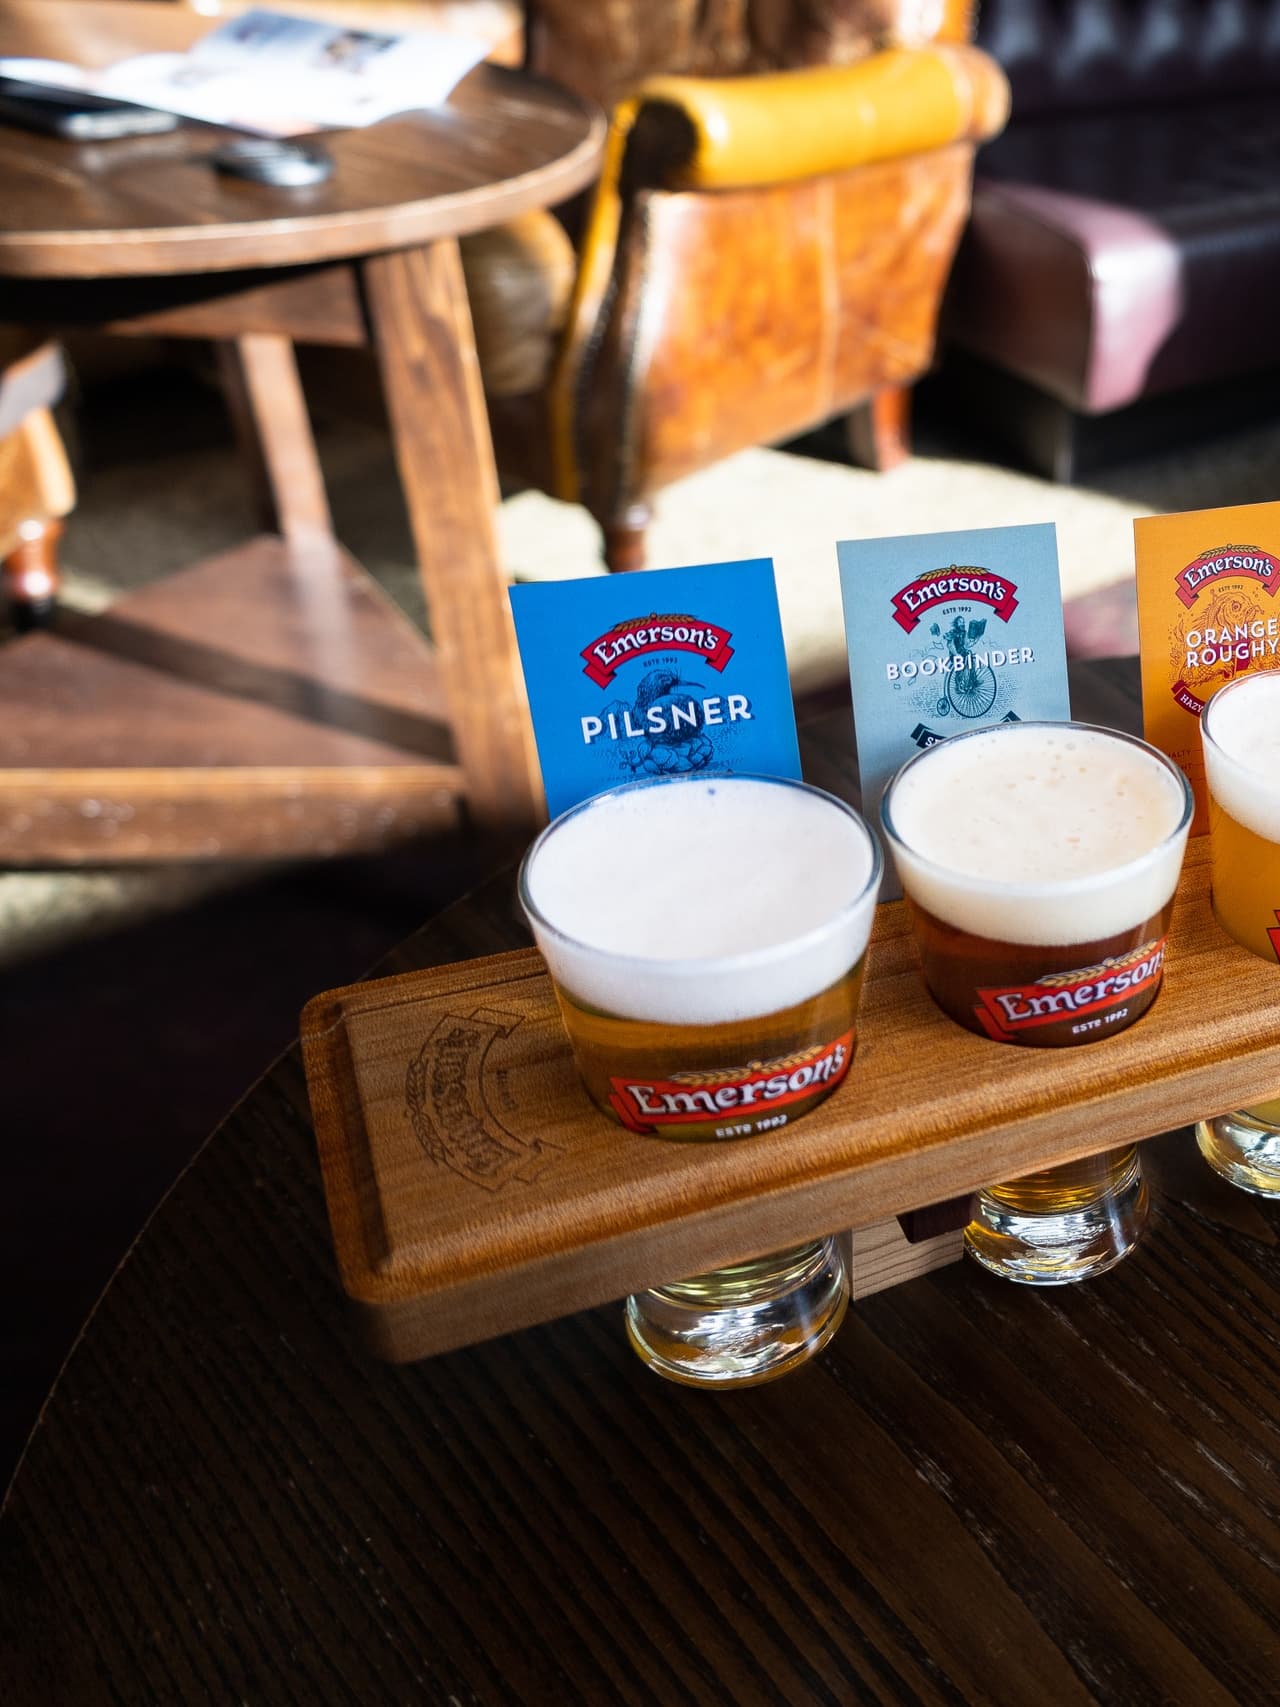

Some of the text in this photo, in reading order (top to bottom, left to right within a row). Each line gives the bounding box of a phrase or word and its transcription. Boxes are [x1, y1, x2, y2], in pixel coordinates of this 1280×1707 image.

[1185, 556, 1273, 588] Emerson's
[902, 577, 1006, 611] Emerson's
[593, 625, 719, 666] Emerson's
[1186, 618, 1278, 648] ORANGE
[886, 647, 1034, 680] BOOKBINDER
[1187, 638, 1279, 668] ROUGHY
[580, 694, 752, 744] PILSNER
[1180, 693, 1204, 713] HAZY
[627, 1043, 847, 1114] Emerson's
